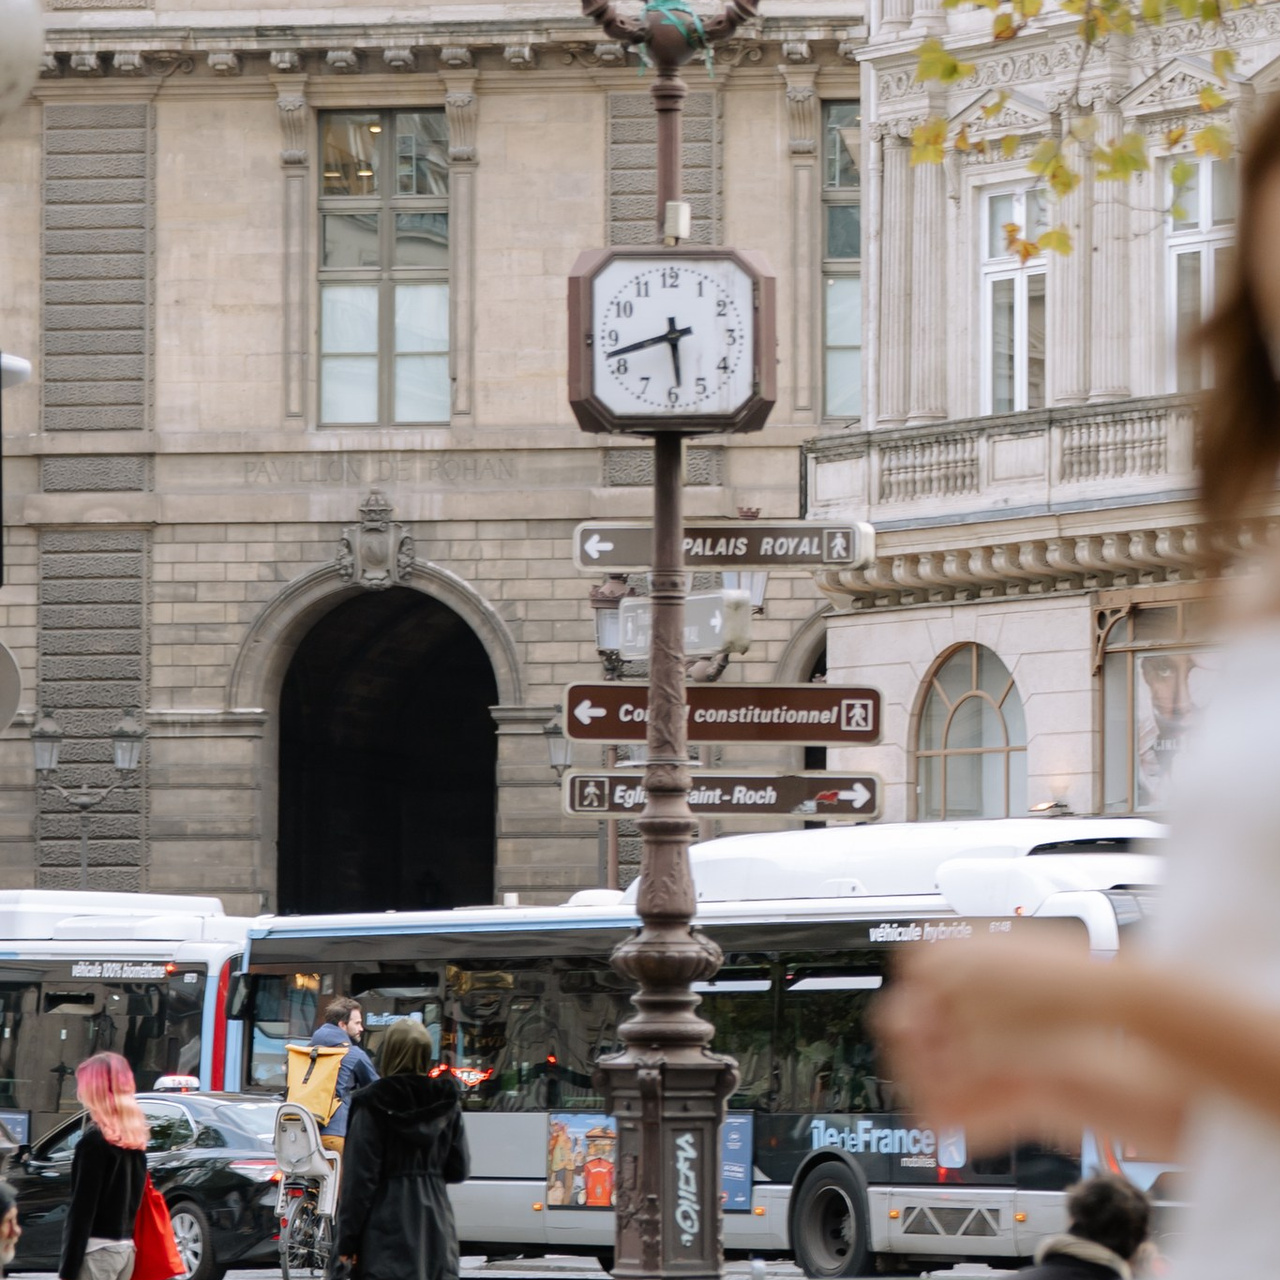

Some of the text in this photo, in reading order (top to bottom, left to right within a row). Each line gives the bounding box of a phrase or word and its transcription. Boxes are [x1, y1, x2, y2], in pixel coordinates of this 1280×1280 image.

[660, 271, 679, 288] 12
[635, 280, 650, 298] 11
[697, 280, 704, 298] 1
[615, 300, 633, 318] 10
[716, 299, 727, 317] 2
[608, 329, 619, 347] 9
[725, 328, 736, 346] 3
[616, 358, 628, 375] 8
[716, 356, 729, 374] 4
[639, 376, 651, 395] 7
[695, 377, 707, 395] 5
[667, 386, 679, 404] 6
[243, 458, 515, 483] PAVILLON DE ROHAN
[682, 537, 821, 556] PALAIS ROYAL
[694, 706, 839, 724] constitutionnel
[869, 922, 972, 943] véhicule hybride
